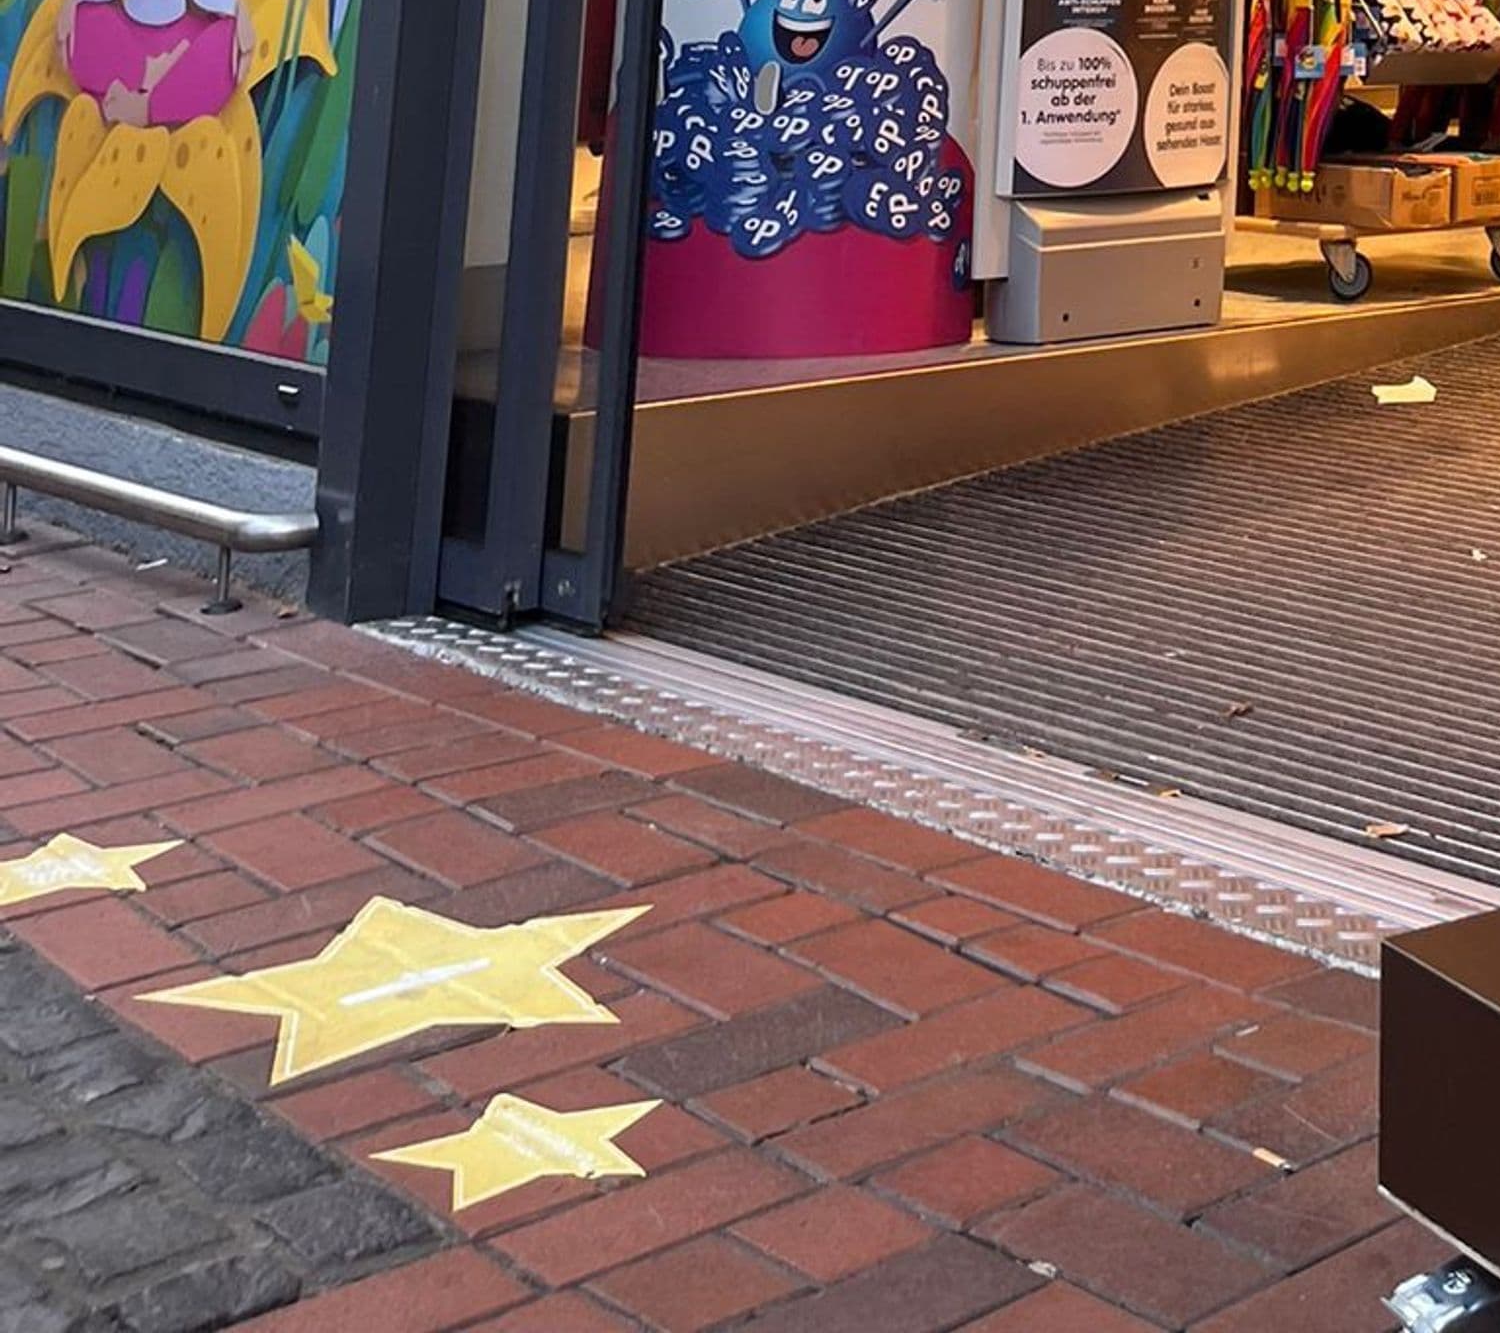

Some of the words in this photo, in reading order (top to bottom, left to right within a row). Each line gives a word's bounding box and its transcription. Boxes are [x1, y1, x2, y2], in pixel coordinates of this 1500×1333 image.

[1037, 58, 1055, 71] Bis
[1061, 60, 1075, 71] zu
[1078, 57, 1112, 70] 100%
[1031, 74, 1116, 92] schuppenfrei
[1169, 83, 1190, 97] Dein
[1051, 92, 1069, 106] ab
[1074, 92, 1097, 106] der
[1021, 111, 1031, 125] 1.
